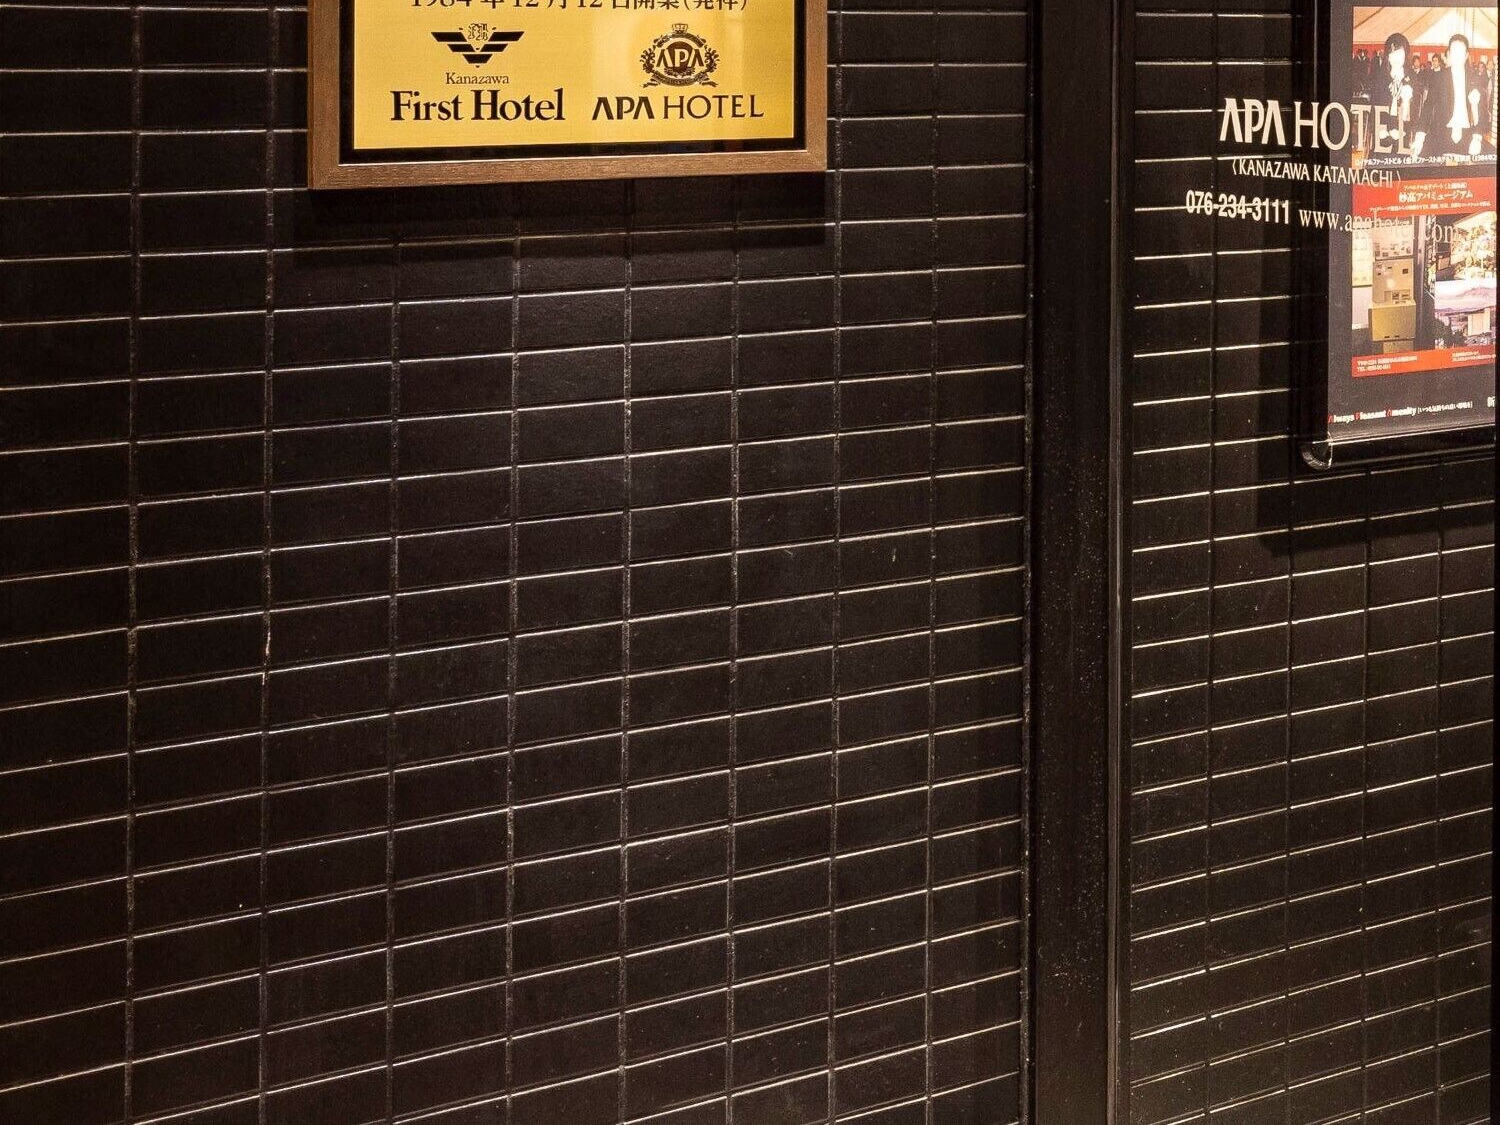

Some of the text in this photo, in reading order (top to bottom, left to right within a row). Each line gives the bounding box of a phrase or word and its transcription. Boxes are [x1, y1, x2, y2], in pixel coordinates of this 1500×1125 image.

[446, 72, 510, 85] Kanazawa
[390, 88, 565, 121] First Hotel
[592, 94, 764, 121] APA HOTEL
[1219, 98, 1413, 155] APA HOTEL
[1186, 189, 1290, 224] 076-234-3111
